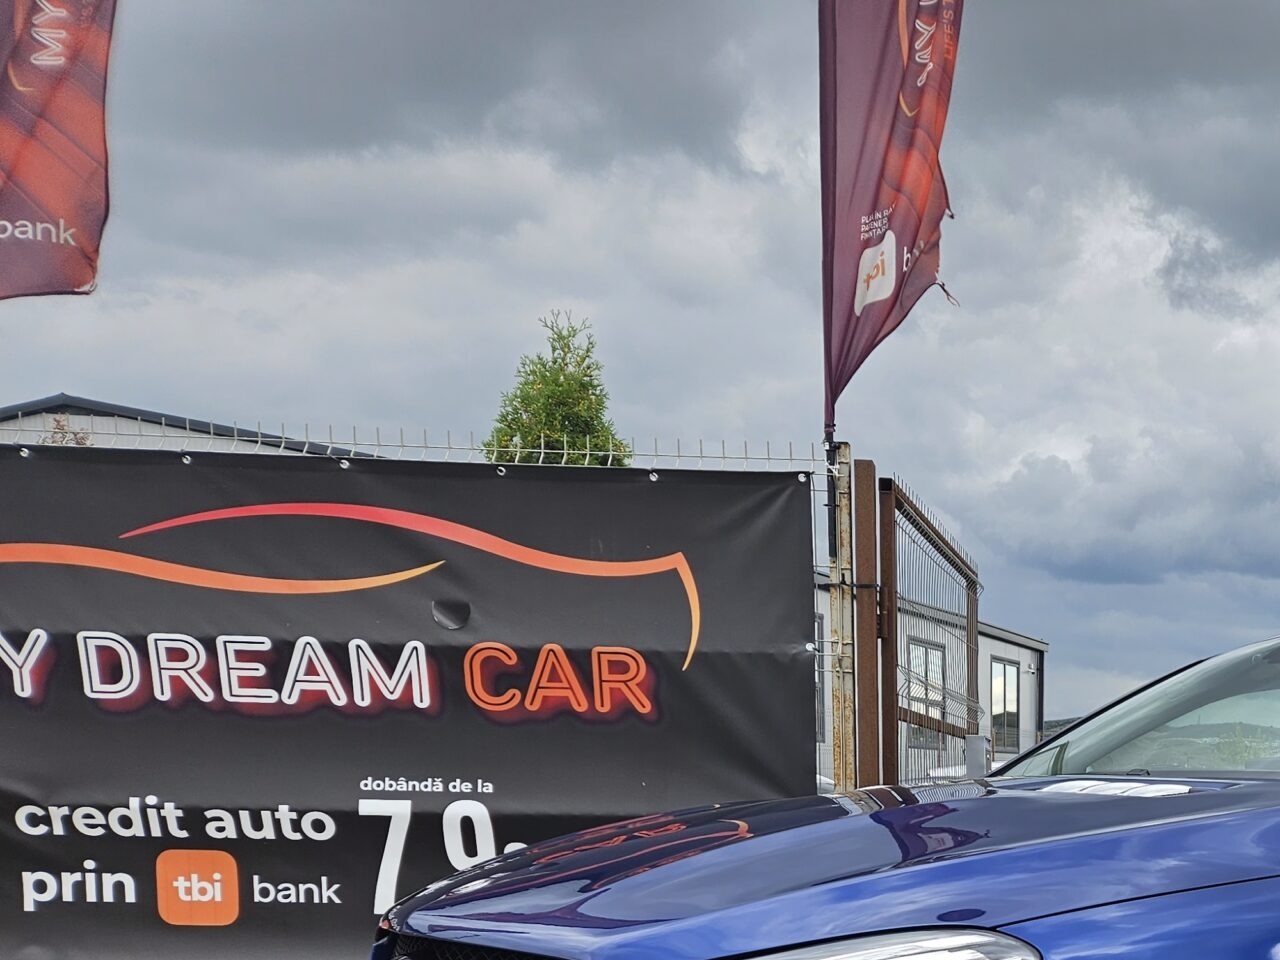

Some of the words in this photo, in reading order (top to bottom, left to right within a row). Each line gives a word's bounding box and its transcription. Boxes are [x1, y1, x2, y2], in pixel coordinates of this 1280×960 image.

[76, 630, 430, 709] DREAM
[463, 641, 652, 714] CAR
[359, 776, 444, 793] dobândă
[448, 778, 473, 793] de
[477, 779, 494, 793] la
[14, 795, 190, 838] credit
[203, 804, 336, 841] auto
[21, 859, 136, 912] prin
[172, 872, 223, 902] tbi
[252, 874, 343, 904] bank
